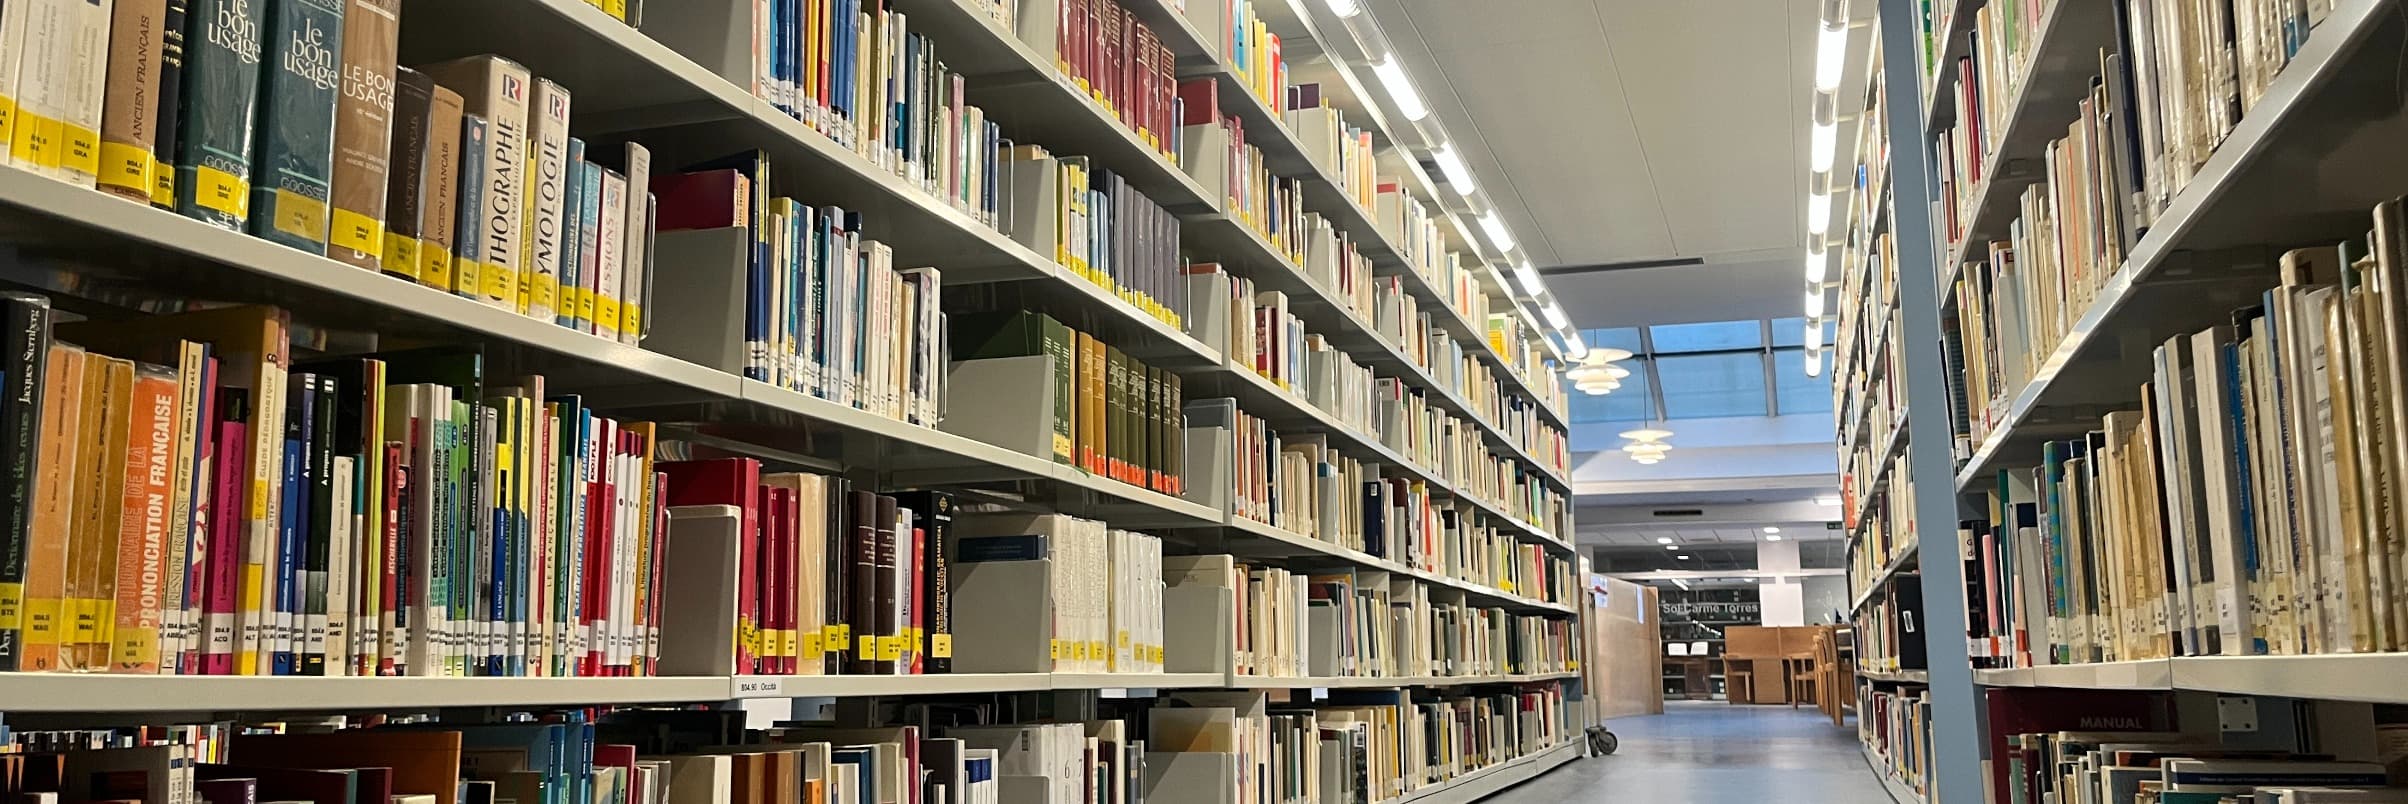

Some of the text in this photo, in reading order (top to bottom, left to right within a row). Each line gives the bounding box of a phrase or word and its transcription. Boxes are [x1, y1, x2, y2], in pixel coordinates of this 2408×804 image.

[218, 0, 256, 41] bon
[305, 18, 324, 46] le
[208, 22, 262, 64] usage
[292, 30, 333, 68] bon
[284, 50, 339, 90] usage
[344, 63, 361, 82] LE
[366, 69, 395, 96] BON
[133, 89, 145, 141] ANCIEN
[344, 79, 394, 113] USAGE
[280, 176, 327, 201] GOOSSE
[537, 132, 559, 276] YMOLOGIE
[23, 309, 40, 362] Sternberg
[18, 364, 35, 405] Jacques
[128, 445, 148, 469] LA
[11, 484, 23, 503] des
[125, 475, 145, 498] DE
[4, 505, 22, 576] Dictionnaire
[547, 505, 555, 569] FRANÇAIS
[577, 496, 586, 554] PROGRESSIVE
[639, 459, 654, 589] Littérature progressive du français
[139, 493, 164, 630] PRONONCIATION
[388, 528, 397, 575] BESCHERELLE
[546, 574, 552, 588] LE
[574, 557, 583, 609] GRAMMAIRE
[1724, 602, 1758, 614] Torres
[2079, 715, 2143, 729] MANUAL
